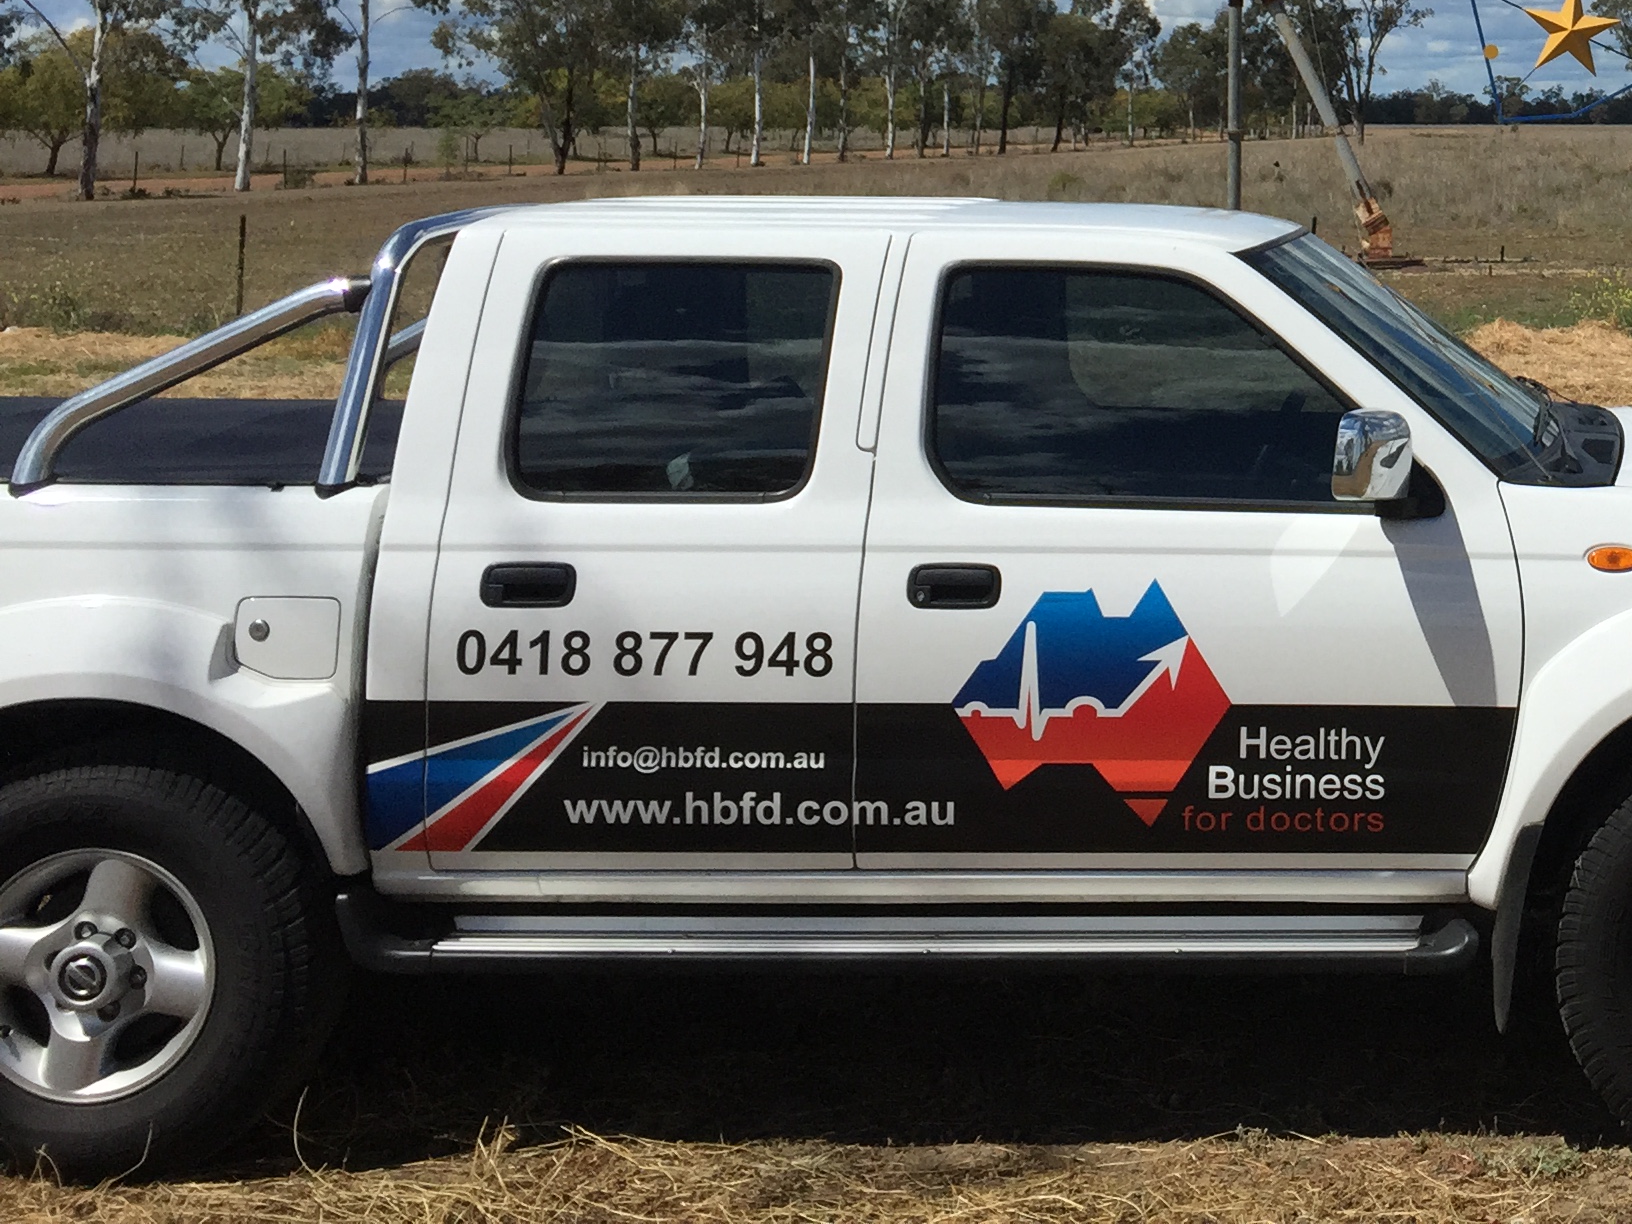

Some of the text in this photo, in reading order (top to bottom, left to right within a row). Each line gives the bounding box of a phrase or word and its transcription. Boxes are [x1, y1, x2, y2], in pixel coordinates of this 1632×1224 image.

[457, 630, 834, 678] 0418 877 948
[581, 745, 826, 774] info@hbfd.com.au
[1238, 726, 1385, 768] Healthy
[1208, 765, 1385, 800] Business
[563, 791, 956, 826] www.hbfd.com.au
[1182, 805, 1384, 832] for doctors
